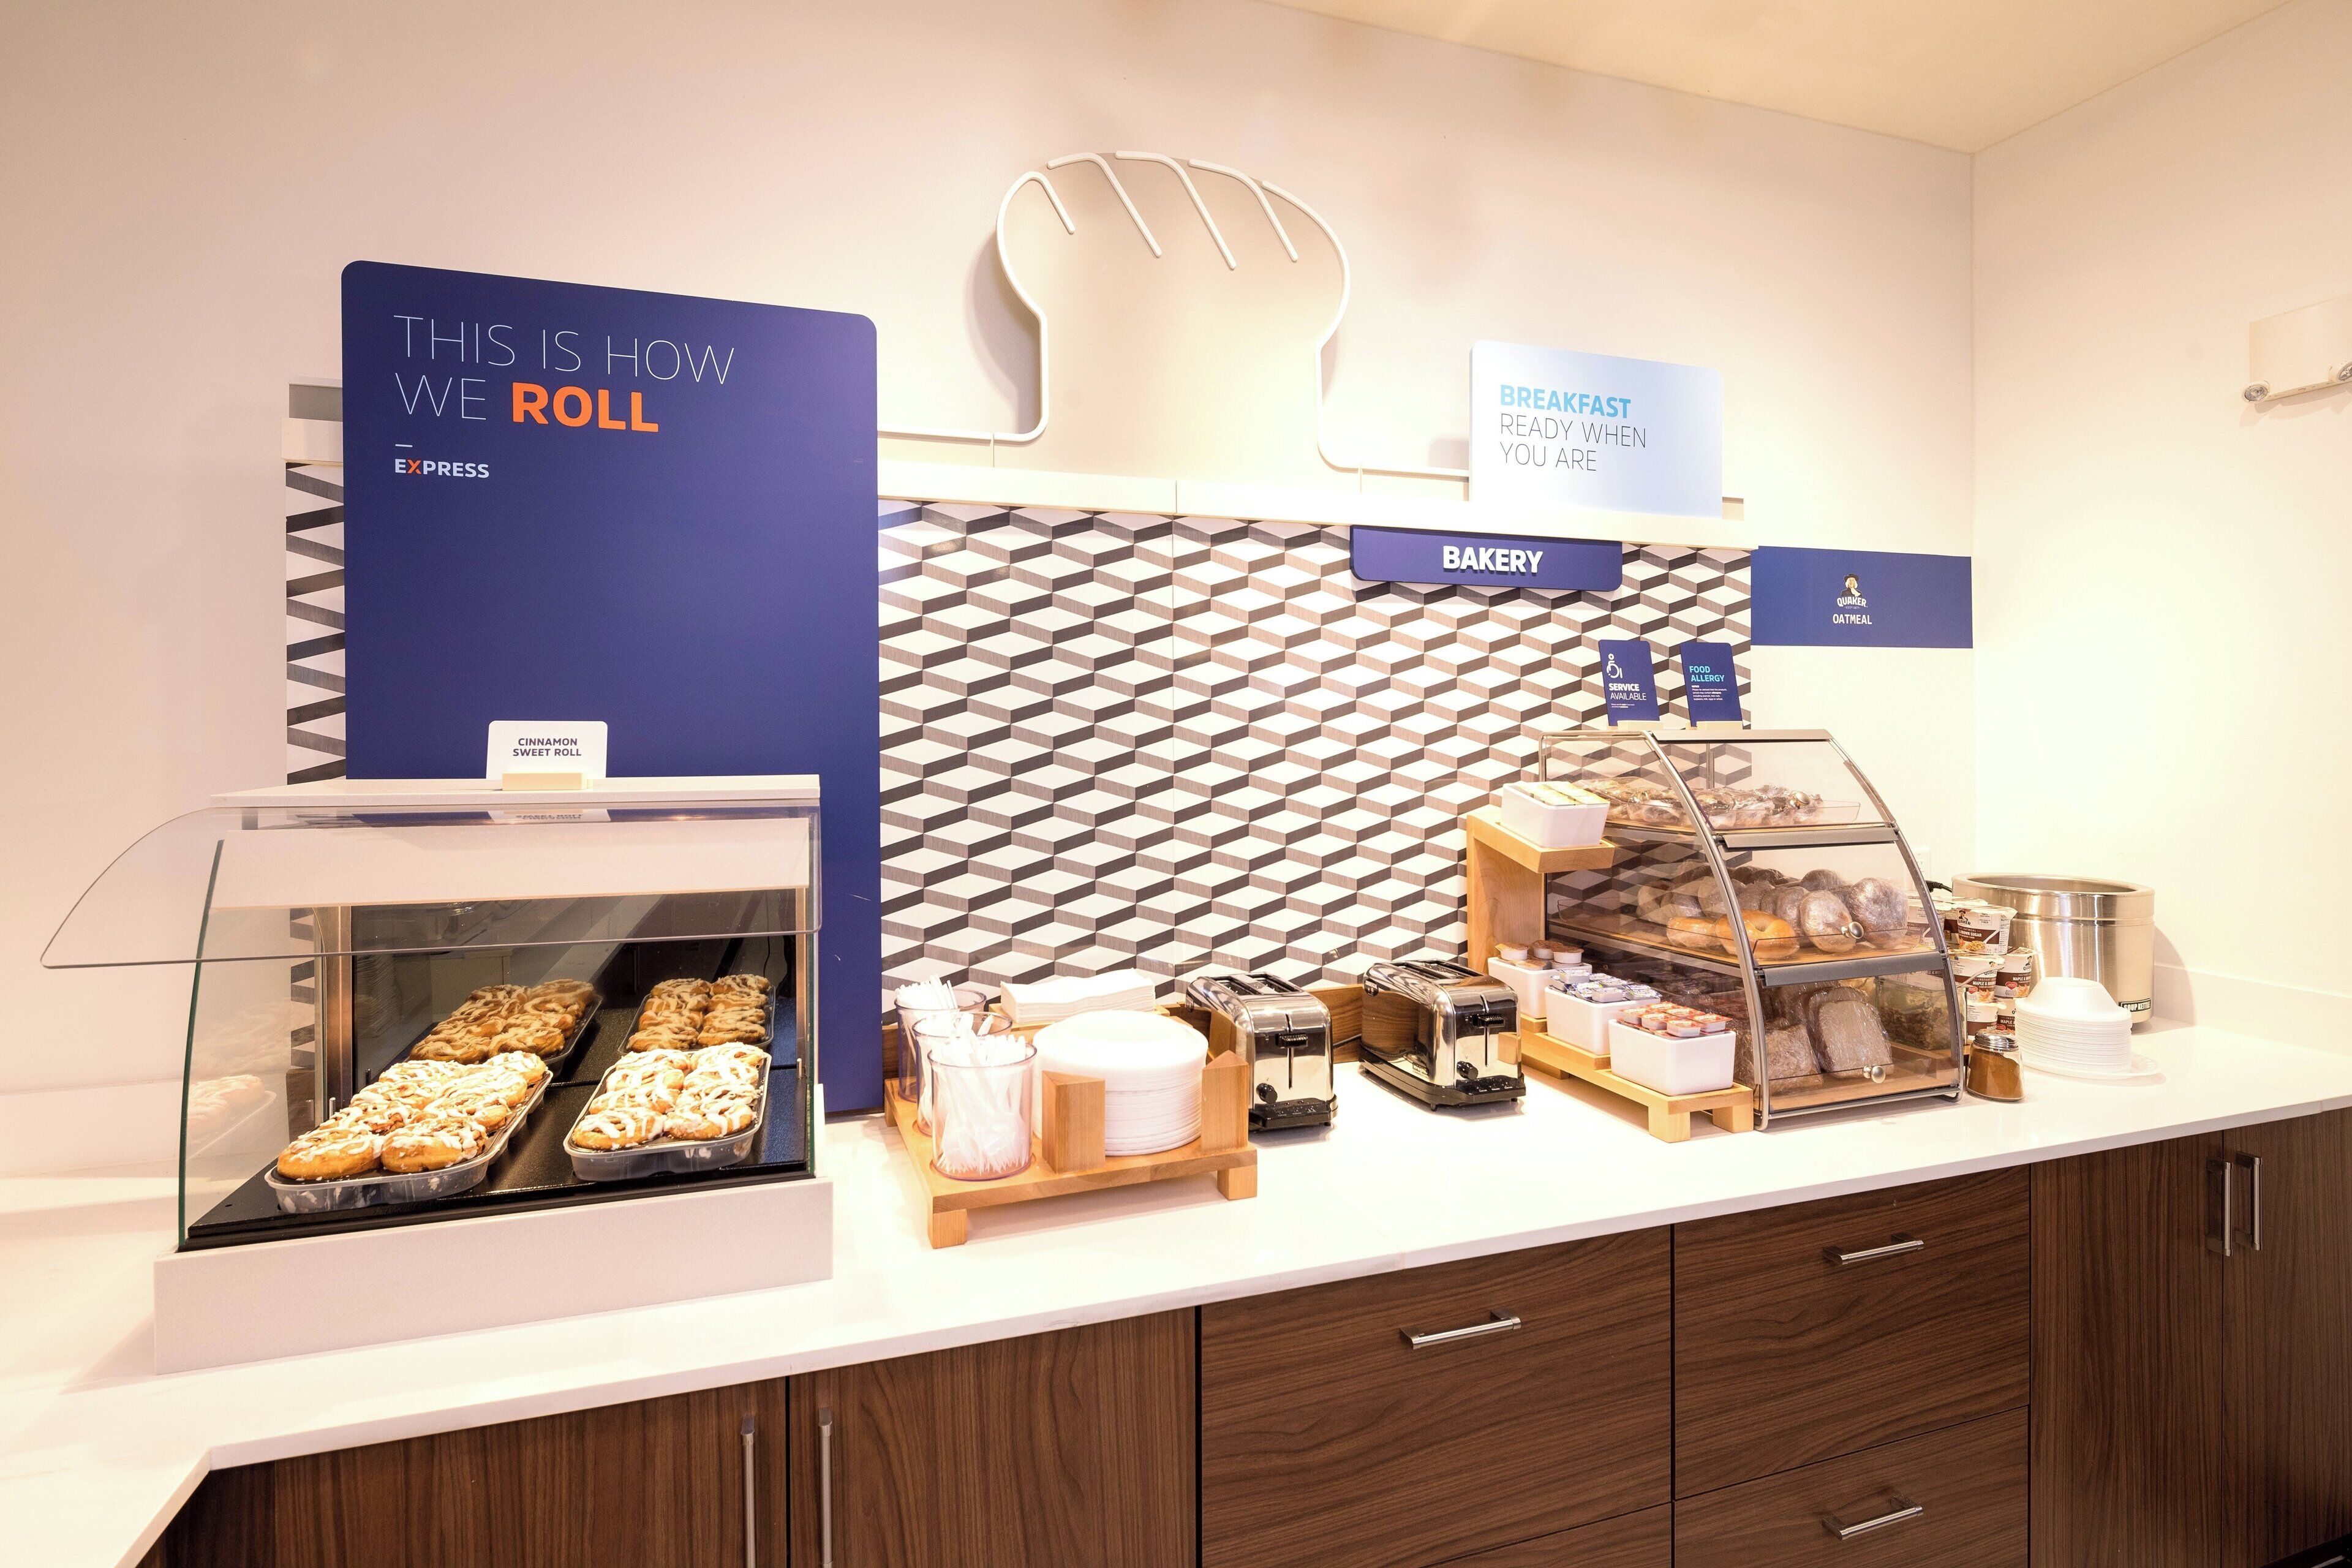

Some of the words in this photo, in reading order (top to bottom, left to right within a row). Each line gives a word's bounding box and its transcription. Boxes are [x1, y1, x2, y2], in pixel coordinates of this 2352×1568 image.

[394, 315, 516, 366] THIS
[542, 330, 581, 372] IS
[606, 335, 734, 385] HOW
[394, 372, 487, 421] WE
[512, 382, 660, 432] ROLL
[1501, 384, 1632, 419] BREAKFAST
[1501, 413, 1574, 441] READY
[1581, 421, 1646, 448] WHEN
[394, 458, 490, 478] EXPRESS
[1500, 442, 1547, 467] YOU
[1556, 448, 1597, 472] ARE
[1443, 545, 1544, 574] BAKERY
[1837, 596, 1867, 608] QUAKER
[1833, 614, 1872, 625] OATMEAL
[1608, 683, 1640, 692] SERVICE
[1610, 692, 1647, 701] AVAILABLE
[2138, 1001, 2150, 1011] KETTLE
